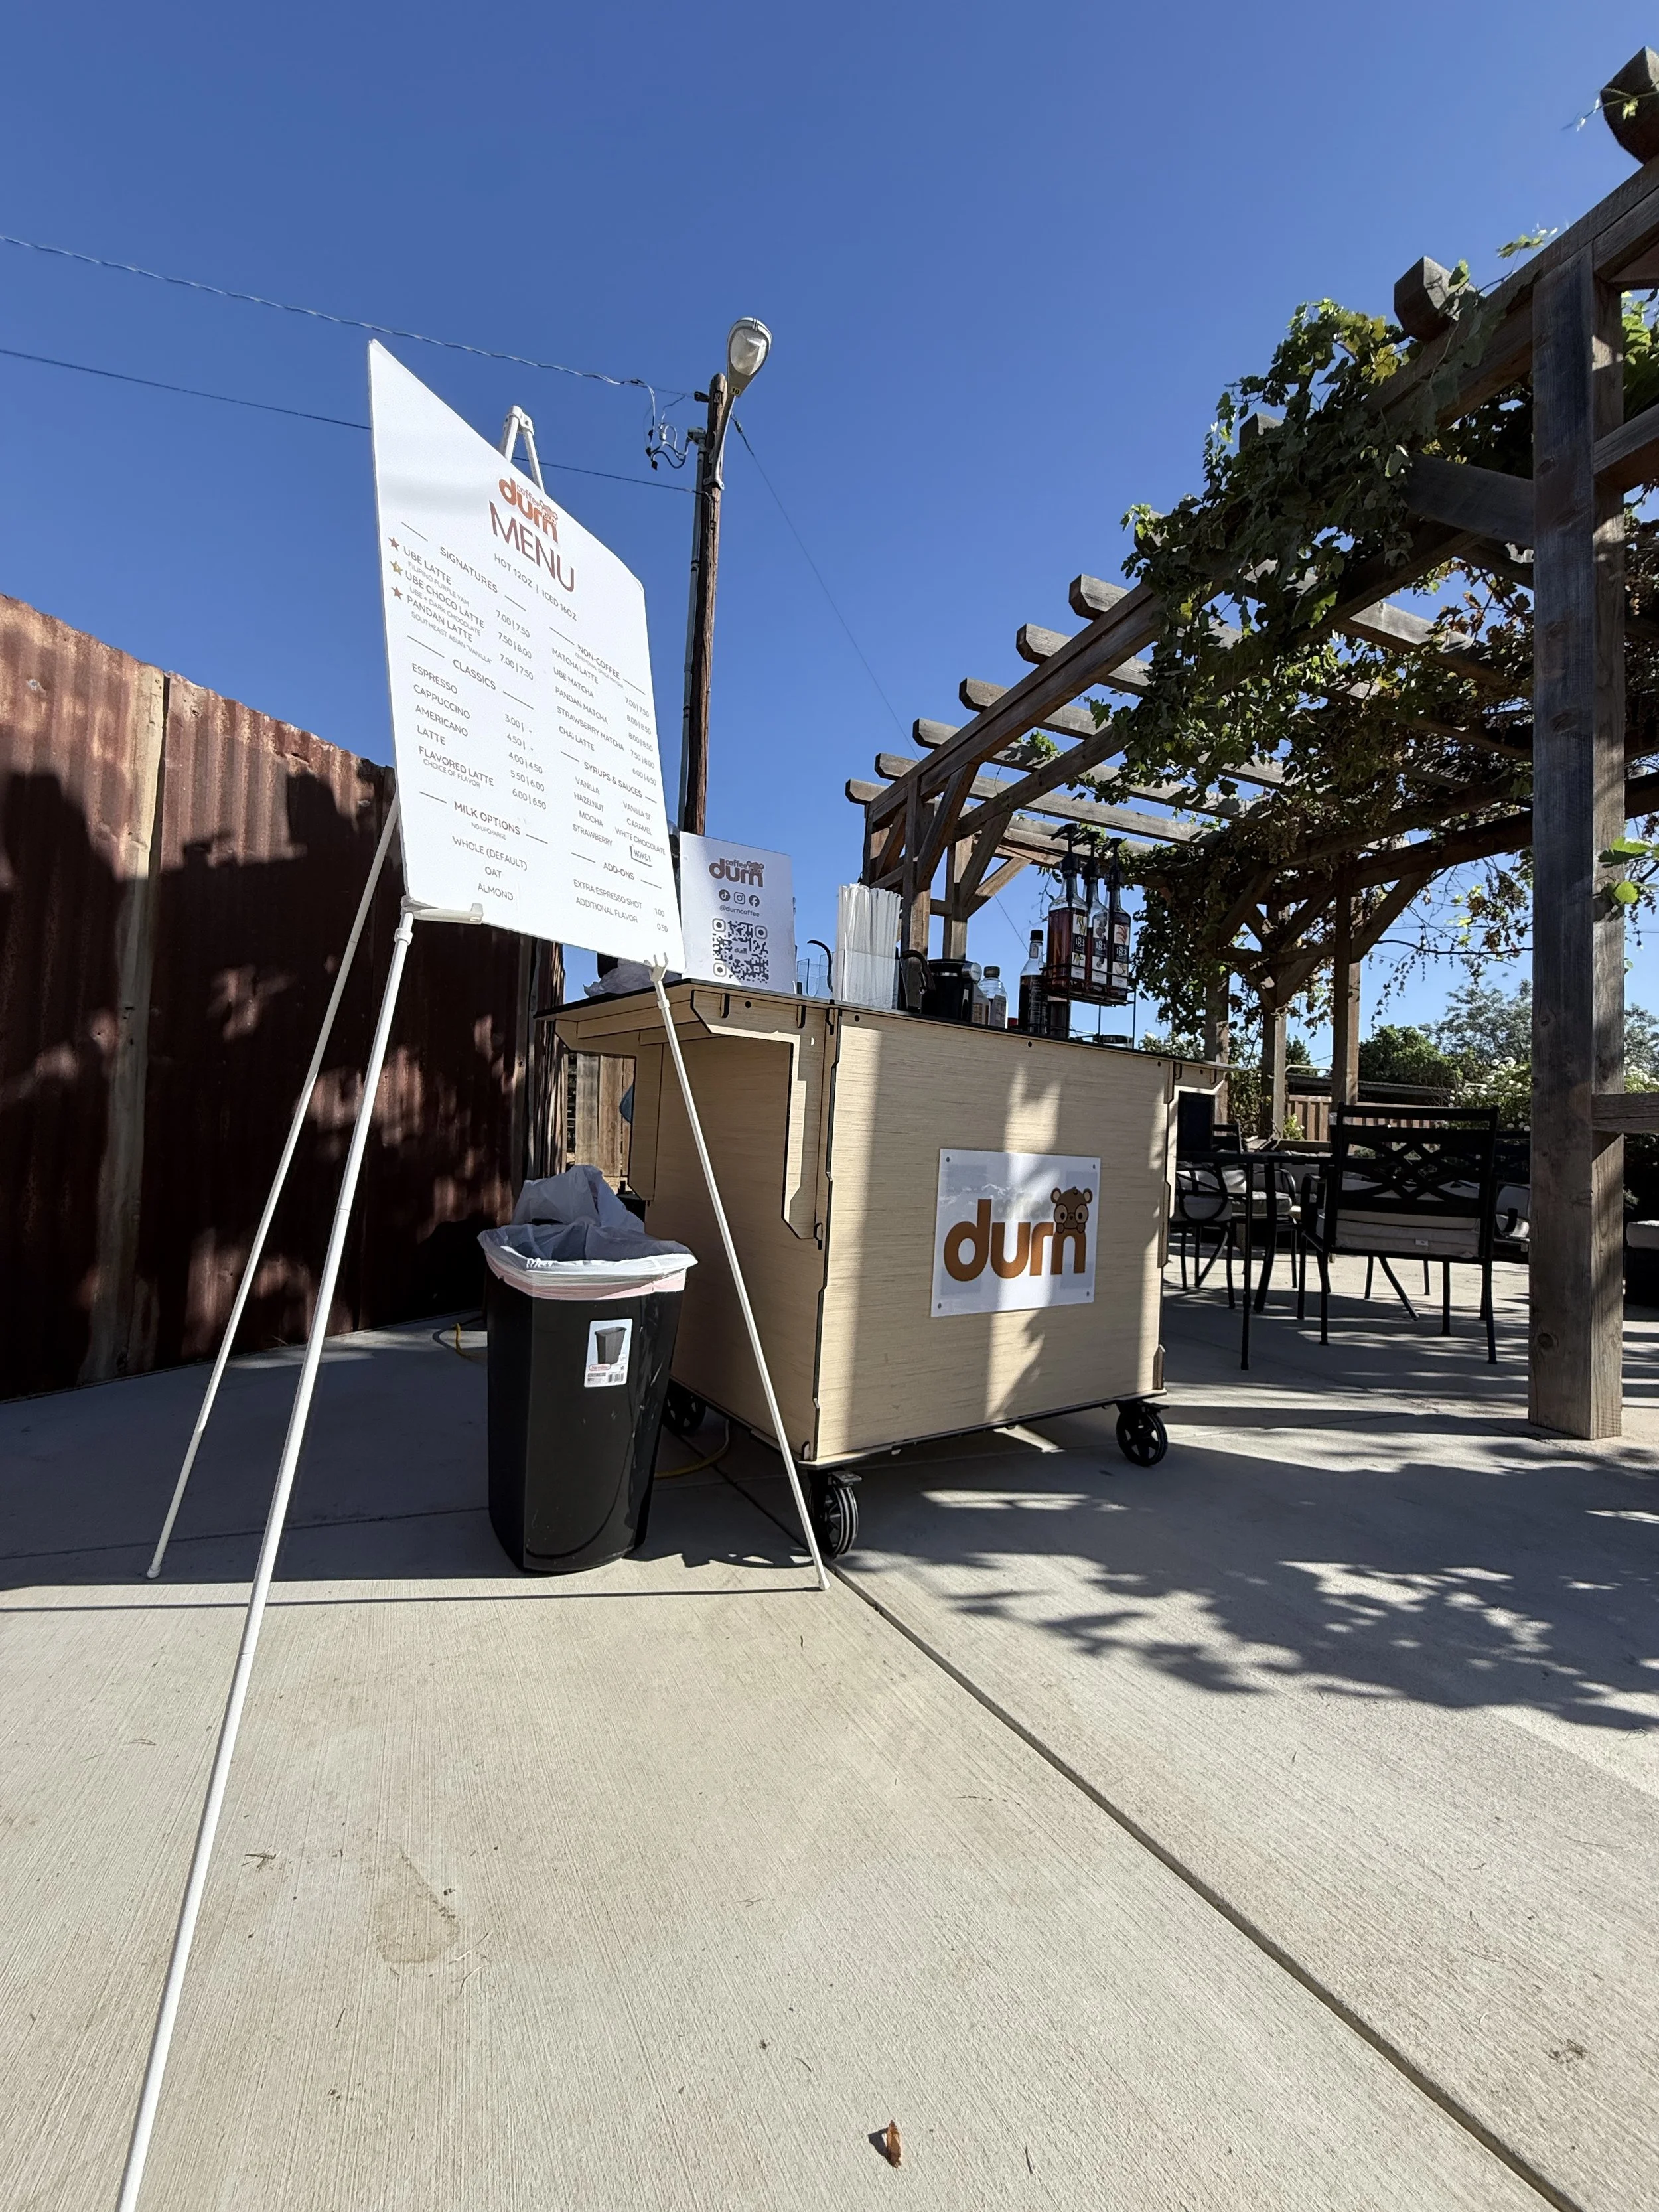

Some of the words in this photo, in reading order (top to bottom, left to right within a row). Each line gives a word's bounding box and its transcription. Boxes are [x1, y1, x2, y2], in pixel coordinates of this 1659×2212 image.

[499, 477, 558, 544] durn
[516, 484, 541, 508] coffee
[489, 500, 574, 592] MENU
[403, 546, 422, 565] UBE
[425, 560, 451, 585] LATTE
[440, 546, 498, 593] SIGNATURES
[405, 570, 424, 589] UBE
[426, 585, 457, 610] CHOCO
[459, 606, 484, 628] LATTE
[408, 561, 433, 582] FILIPINO
[434, 580, 456, 597] PURPLE
[457, 595, 470, 607] YAM
[494, 553, 511, 571] HOT
[514, 568, 532, 588] 12OZ
[541, 589, 559, 607] ICED
[560, 604, 577, 621] 16OZ
[407, 595, 445, 625] PANDAN
[447, 620, 473, 643] LATTE
[410, 586, 423, 599] UBE
[429, 599, 446, 615] DARK
[447, 611, 480, 636] CHOCOLATE
[411, 611, 447, 637] SOUTHEAST
[449, 634, 465, 649] ASIAN
[453, 659, 496, 690] CLASSICS
[552, 648, 579, 672] MATCHA
[580, 666, 599, 684] LATTE
[578, 644, 620, 680] NON-COFFEE
[411, 662, 457, 694] ESPRESSO
[553, 667, 567, 681] UBE
[568, 676, 594, 698] MATCHA
[413, 684, 470, 719] CAPPUCCINO
[555, 686, 582, 708] PANDAN
[583, 703, 608, 724] MATCHA
[415, 705, 468, 737] AMERICANO
[417, 725, 446, 745] LATTE
[557, 706, 599, 736] STRAWBERRY
[601, 733, 624, 751] MATCHA
[559, 726, 574, 739] CHAI
[575, 735, 595, 751] LATTE
[419, 746, 466, 774] FLAVORED
[469, 768, 494, 786] LATTE
[423, 758, 447, 774] CHOICE
[457, 773, 480, 788] FLAVOR
[584, 762, 611, 782] SYRUPS
[618, 780, 642, 798] SAUCES
[575, 776, 600, 795] VANILLA
[574, 792, 604, 812] HAZELNUT
[623, 801, 644, 818] VANILLA
[454, 801, 478, 819] MILK
[480, 812, 520, 835] OPTIONS
[480, 824, 506, 840] UPCHARGE
[579, 810, 603, 827] MOCHA
[626, 818, 652, 836] CARAMEL
[573, 824, 613, 846] STRAWBERRY
[615, 827, 633, 841] WHITE
[634, 836, 666, 855] CHOCOLATE
[452, 835, 484, 855] WHOLE
[486, 848, 527, 871] (DEFAULT)
[634, 849, 651, 862] HONEY
[725, 859, 747, 869] coffee
[485, 866, 502, 879] OAT
[603, 862, 634, 880] ADD-ONS
[709, 858, 763, 887] durn
[478, 883, 514, 900] ALMOND
[573, 879, 595, 893] EXTRA
[596, 887, 626, 904] ESPRESSO
[626, 898, 642, 909] SHOT
[576, 897, 613, 916] ADDITIONAL
[614, 909, 638, 923] FLAVOR
[719, 905, 760, 917] @durncoffee
[944, 1199, 1086, 1282] durn
